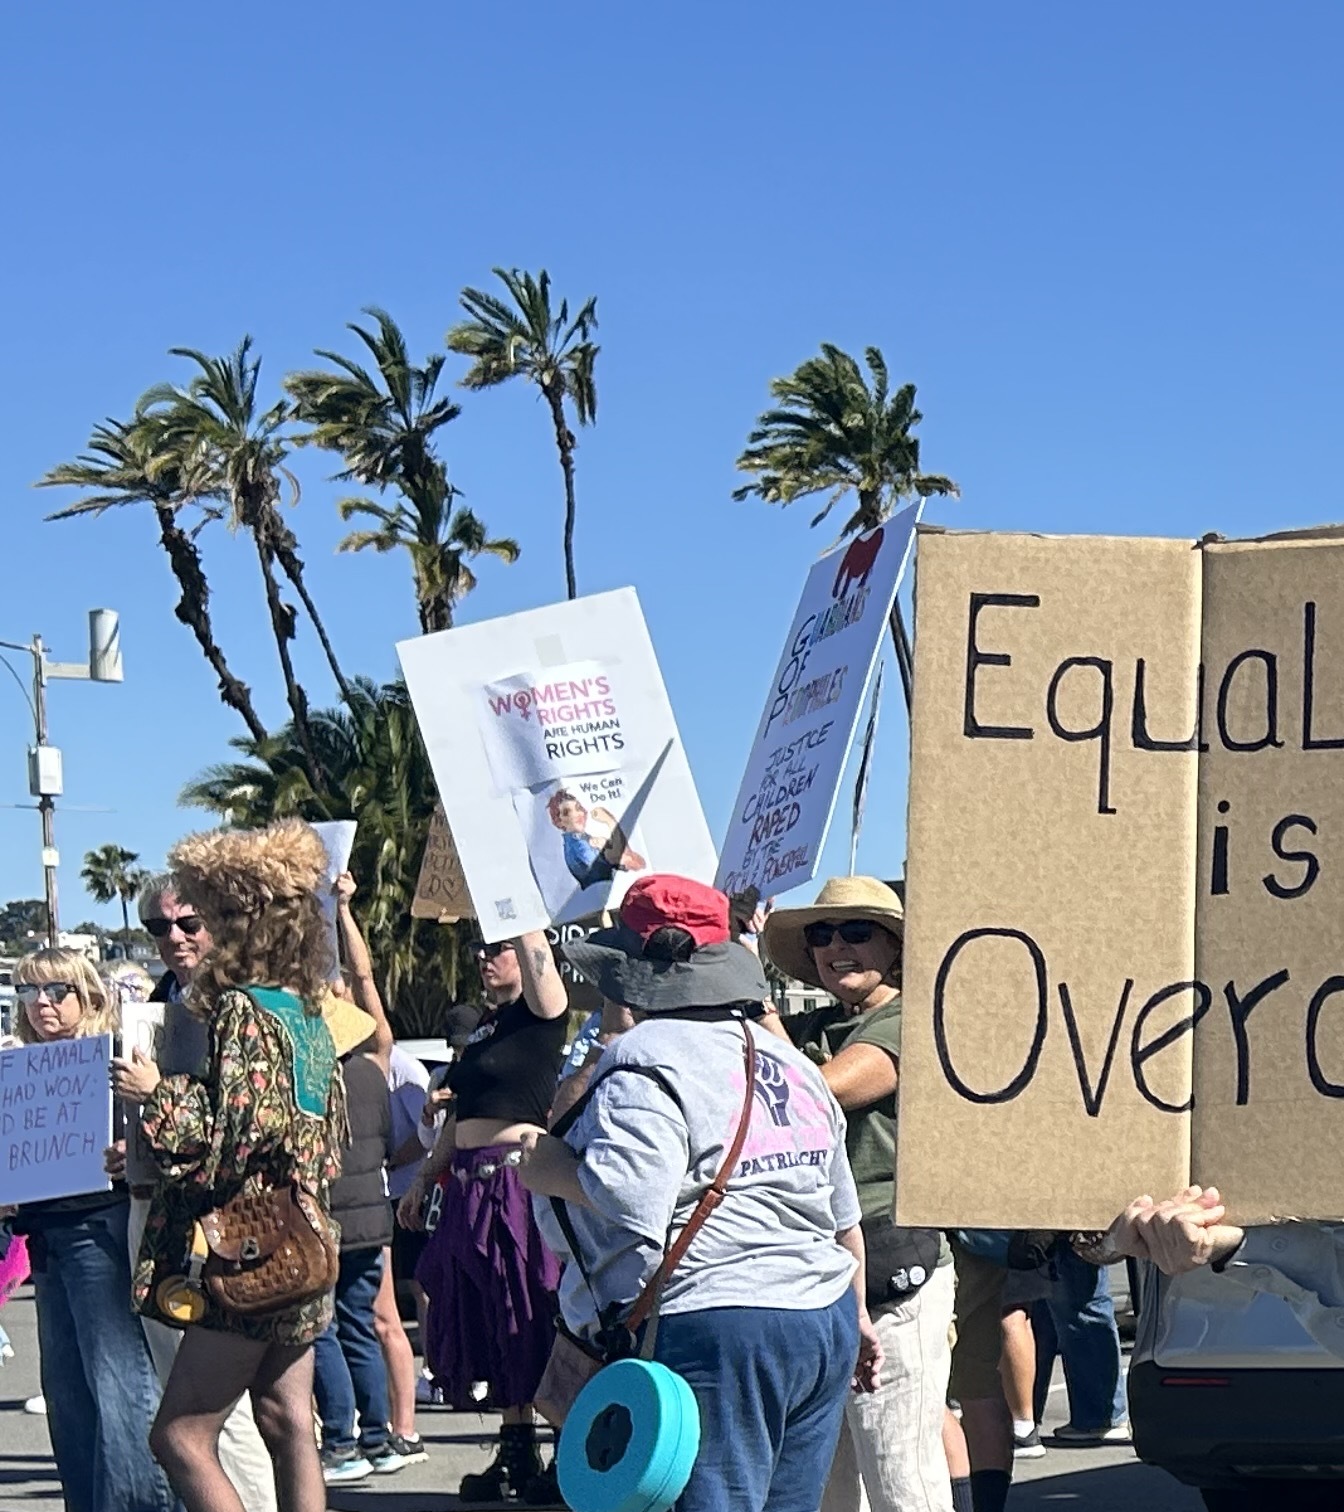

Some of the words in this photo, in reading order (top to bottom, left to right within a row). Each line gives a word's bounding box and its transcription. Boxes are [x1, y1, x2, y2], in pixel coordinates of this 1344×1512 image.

[778, 649, 811, 695] OF
[488, 675, 611, 721] WOMEN'S
[536, 698, 617, 726] RIGHTS
[543, 726, 569, 740] ARE
[570, 718, 621, 735] HUMAN
[545, 732, 625, 760] RIGHTS
[765, 720, 834, 772] JUSTICE
[579, 781, 599, 793] We
[600, 777, 623, 790] Can
[590, 792, 606, 803] Do
[608, 789, 621, 801] It!
[742, 763, 820, 824] CHILDREN
[749, 801, 801, 851] RAPED
[1210, 799, 1321, 899] is
[0, 1055, 15, 1083] F
[26, 1038, 105, 1077] KAMALA
[2, 1082, 36, 1109] HAD
[45, 1073, 98, 1098] WON:
[24, 1106, 48, 1130] BE
[56, 1101, 82, 1126] AT
[9, 1131, 96, 1171] BRUNCH
